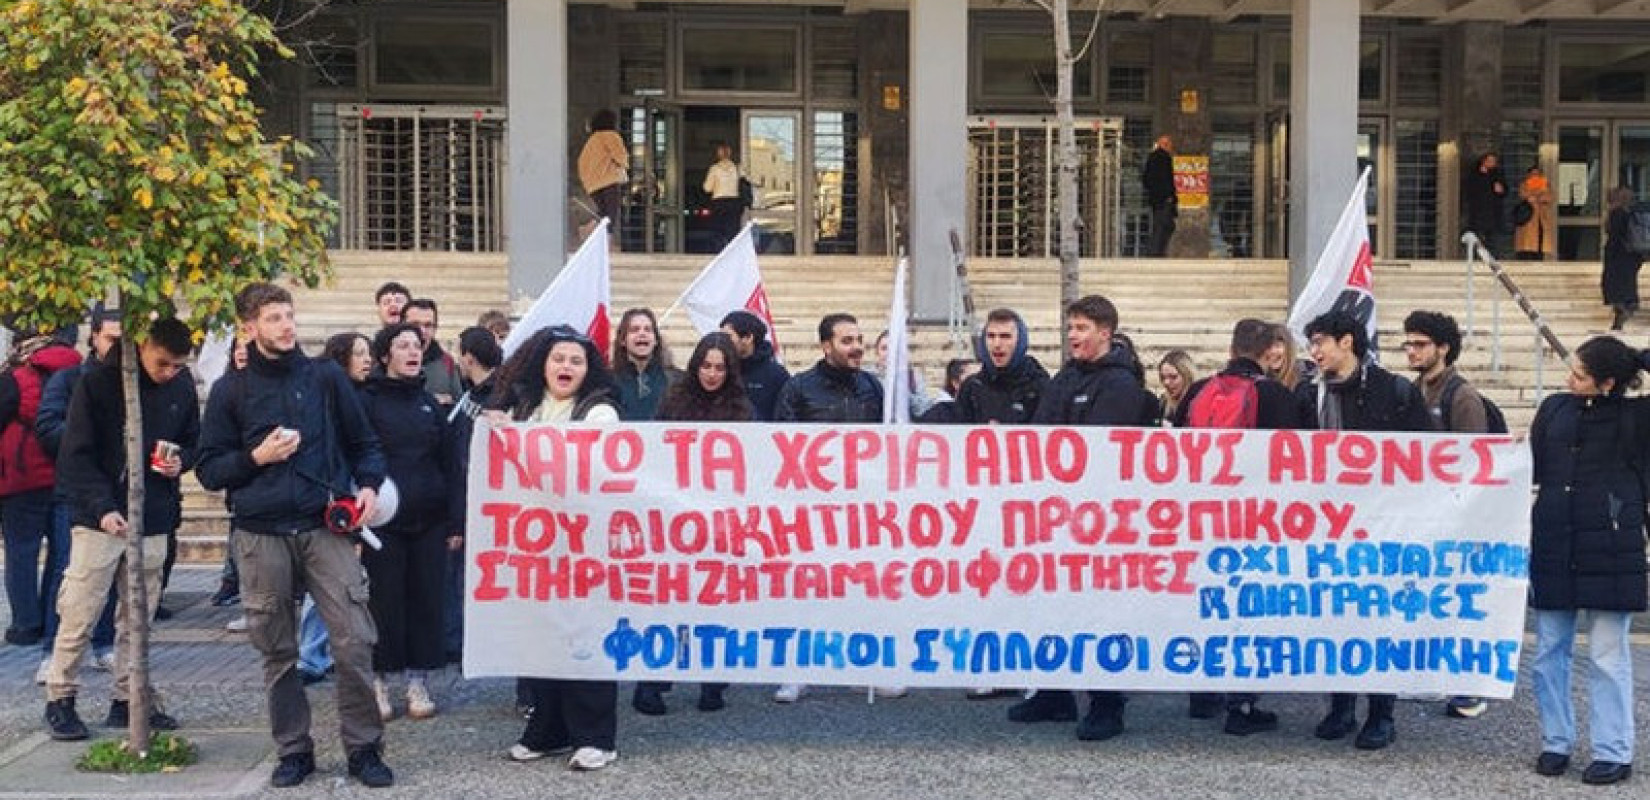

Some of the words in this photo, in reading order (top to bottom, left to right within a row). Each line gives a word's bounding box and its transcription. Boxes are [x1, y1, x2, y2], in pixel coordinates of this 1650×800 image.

[488, 427, 645, 496] ΚΑΤΩ
[663, 429, 747, 495] ΤΑ
[773, 430, 950, 493] ΧΕΡΙΑ
[965, 428, 1088, 486] ΑΠΟ
[1108, 430, 1243, 486] ΤΟΥΣ
[1268, 431, 1512, 486] ΑΓΩΝΕΣ
[481, 503, 589, 554] ΤΟΥ
[607, 498, 980, 560] ΔΙΟΙΚΗΤΙΚΟΥ
[1001, 495, 1369, 548] ΠΡΟΣΩΠΙΚΟΥ.
[1206, 543, 1290, 576] ΟΧΙ
[473, 550, 689, 606] ΣΤΗΡΙΞΗ
[695, 560, 908, 607] ΖΗΤΑΜΕ
[965, 548, 1199, 598] ΦΟΙΤΗΤΕΣ
[603, 617, 897, 672] ΦΟΙΤΗΤΙΚΟΙ
[910, 627, 1151, 675] ΣΥΛΛΟΓΟΙ
[1163, 635, 1519, 683] ΘΕΣΣΑΛΟΝΙΚΗΣ
